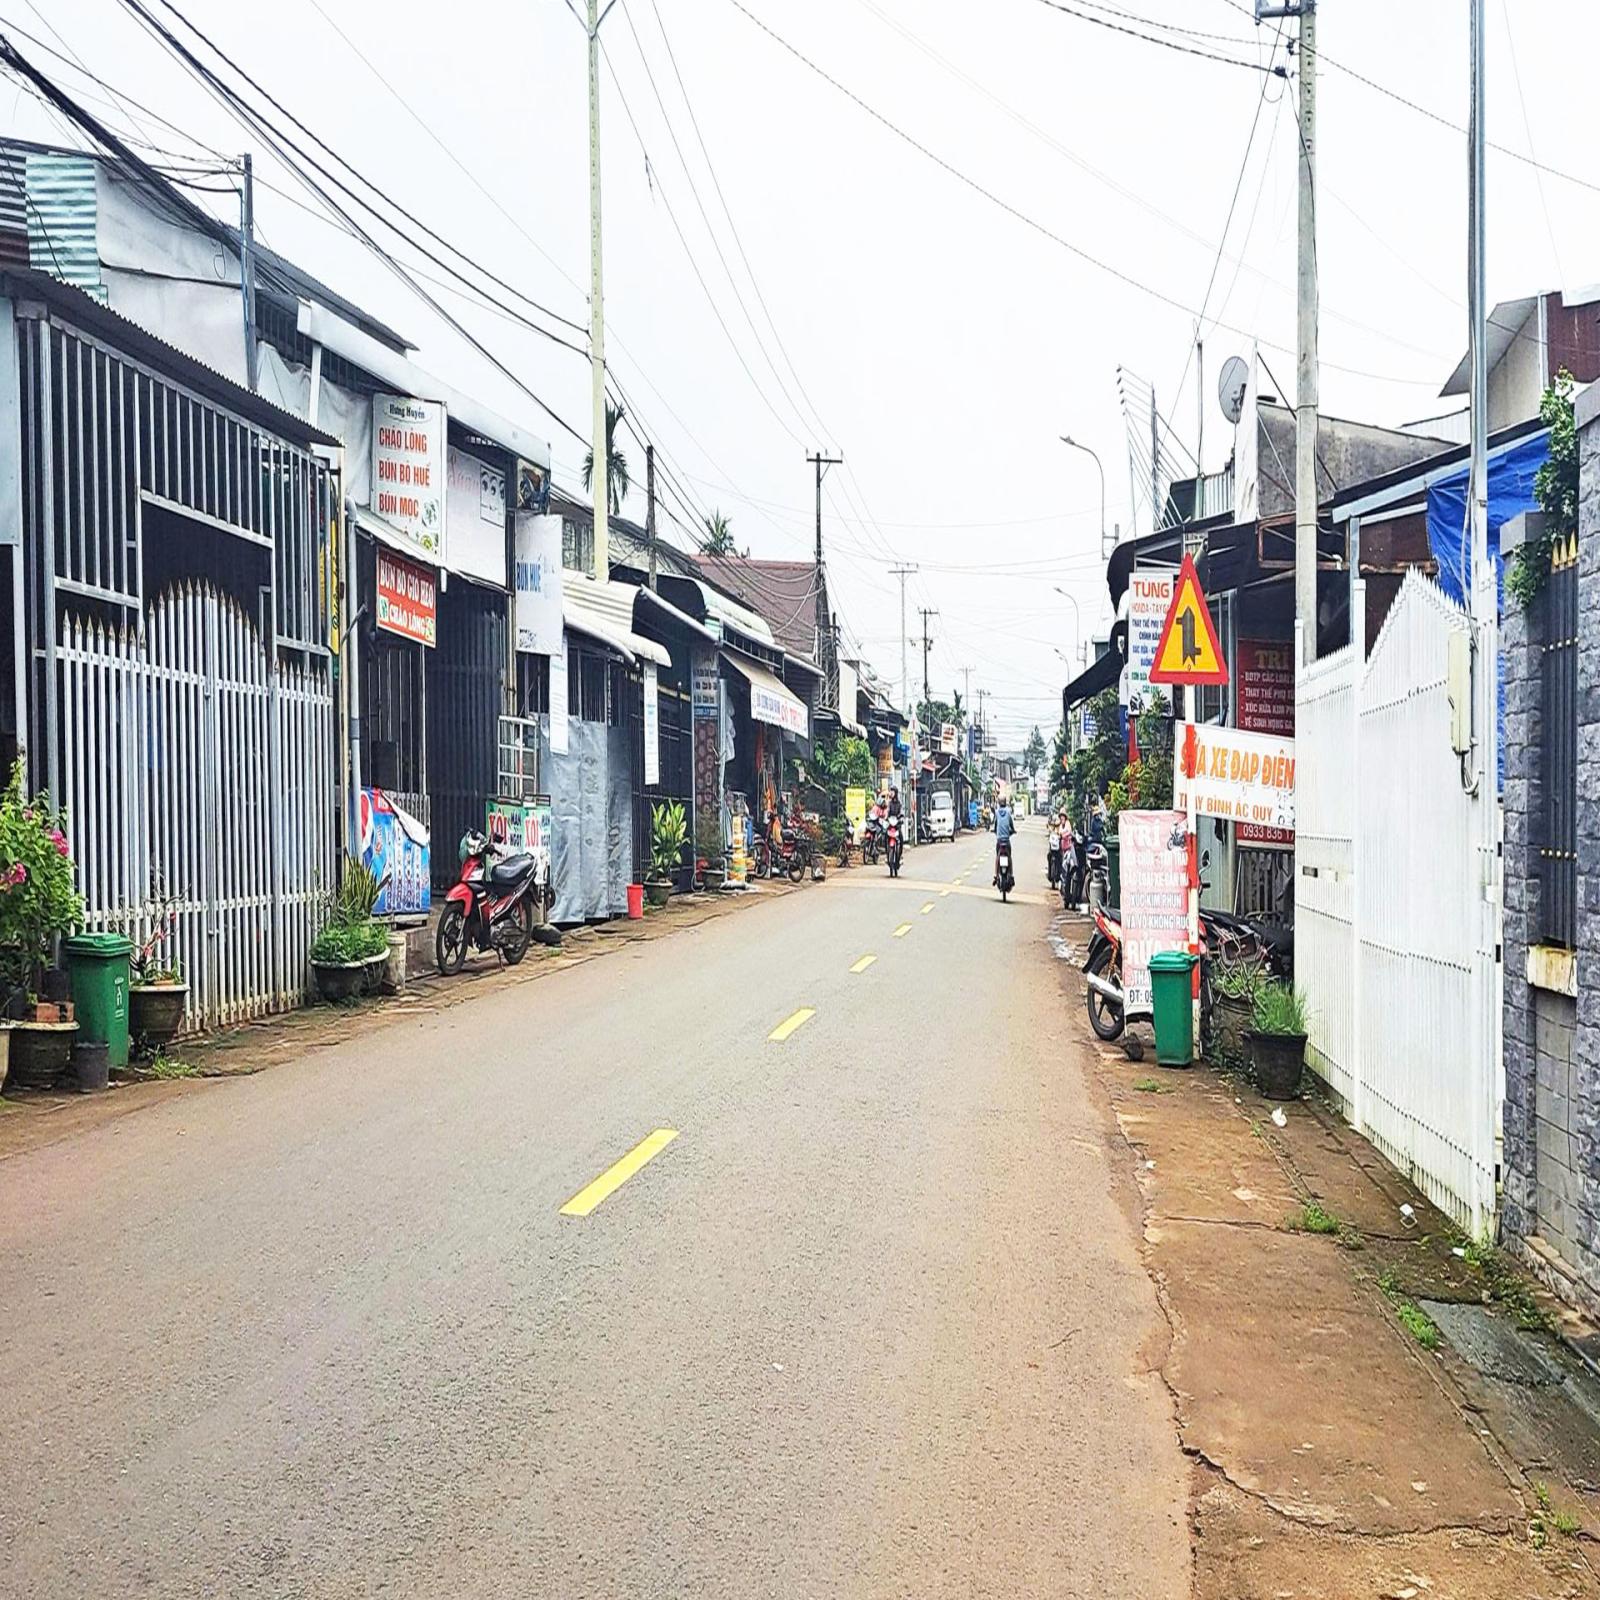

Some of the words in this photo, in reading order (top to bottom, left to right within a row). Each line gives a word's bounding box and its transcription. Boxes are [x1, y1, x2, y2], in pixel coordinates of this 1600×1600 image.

[379, 458, 397, 482] BÚN
[379, 490, 397, 516] BÚN
[1209, 746, 1228, 779] XE
